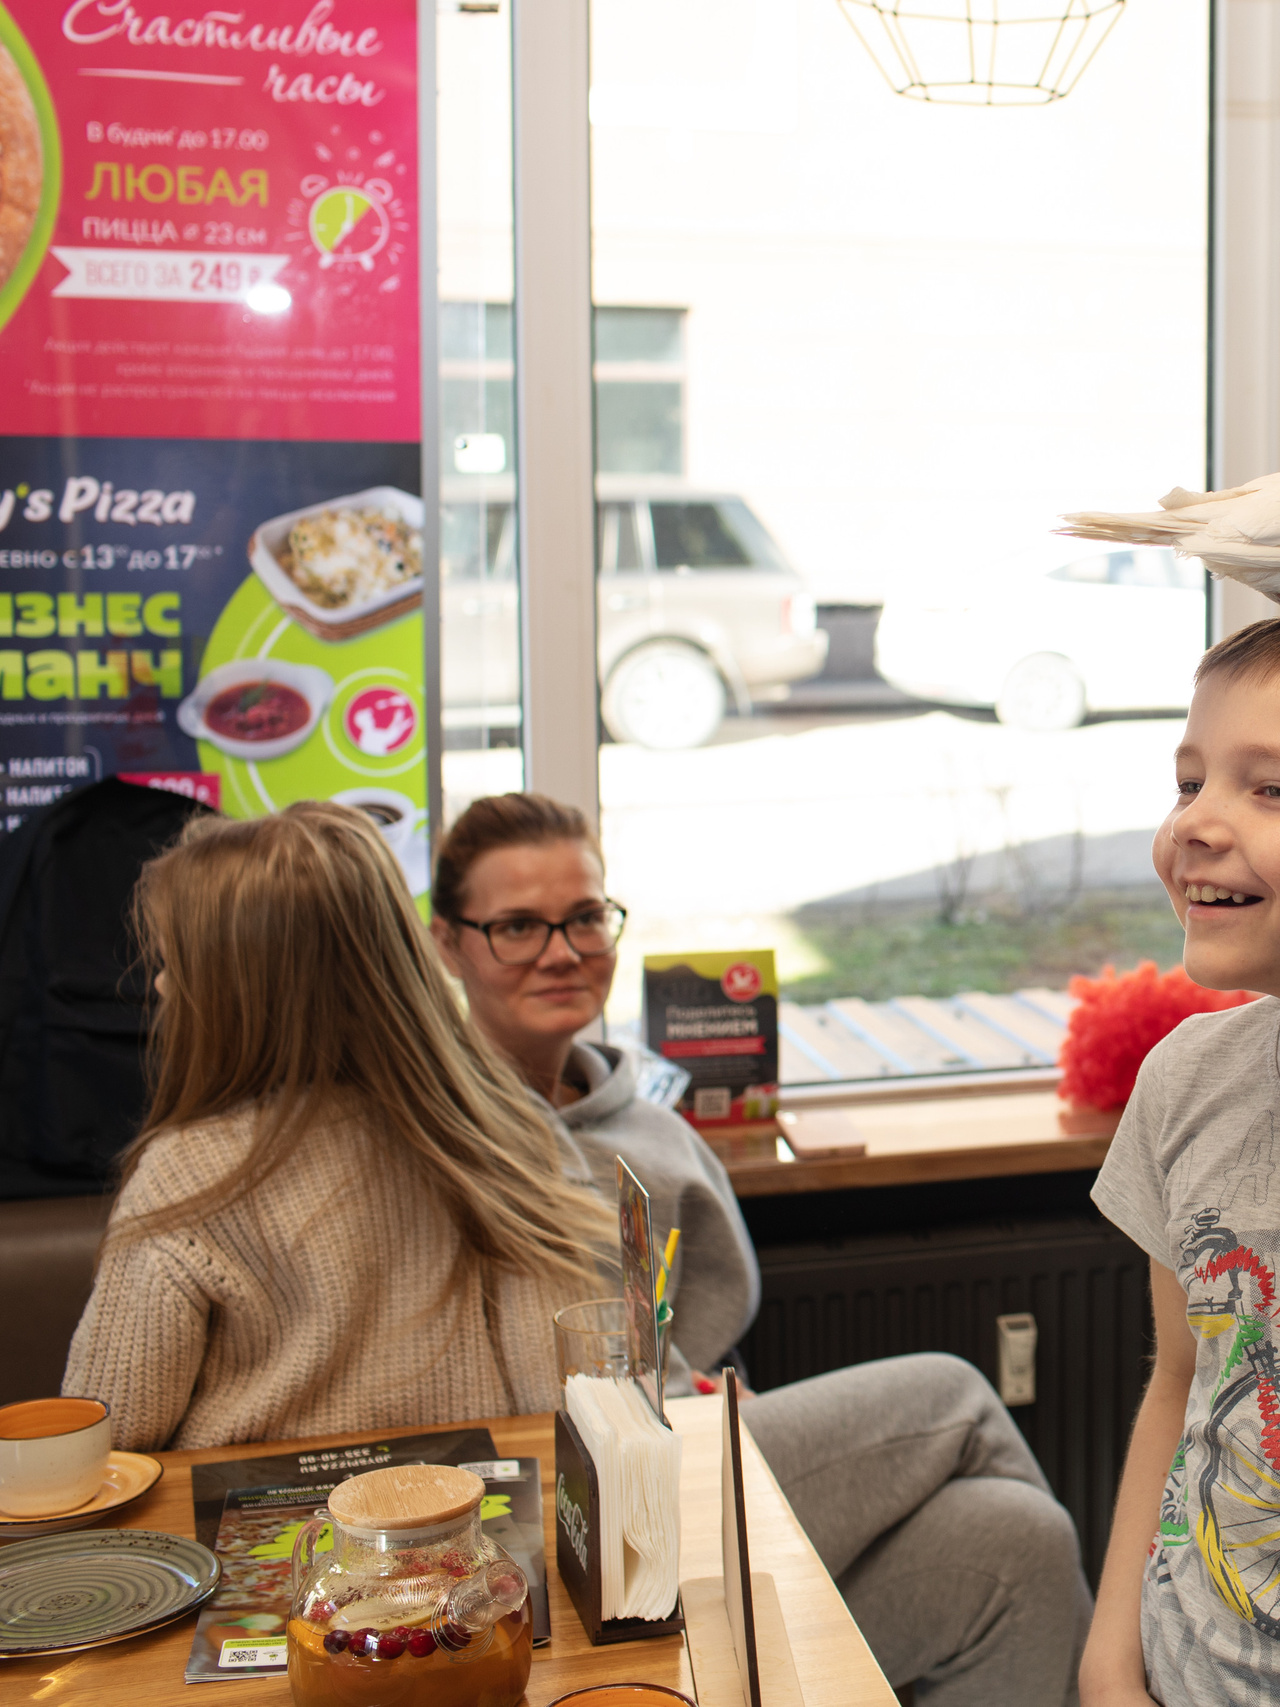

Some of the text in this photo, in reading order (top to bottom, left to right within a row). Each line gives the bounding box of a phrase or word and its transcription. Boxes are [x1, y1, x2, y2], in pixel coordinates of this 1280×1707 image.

[63, 0, 382, 57] Счастливые
[263, 63, 385, 106] часы
[86, 121, 270, 151] В будни до 17.00
[84, 161, 269, 208] ЛЮБАЯ
[82, 216, 179, 245] ПИЦЦА
[86, 259, 148, 288] ВСЕГО
[155, 262, 182, 289] ЗА
[190, 260, 241, 292] 249
[59, 475, 196, 527] Pizza
[8, 756, 90, 778] НАПИТОК
[6, 785, 72, 806] НАПИТ
